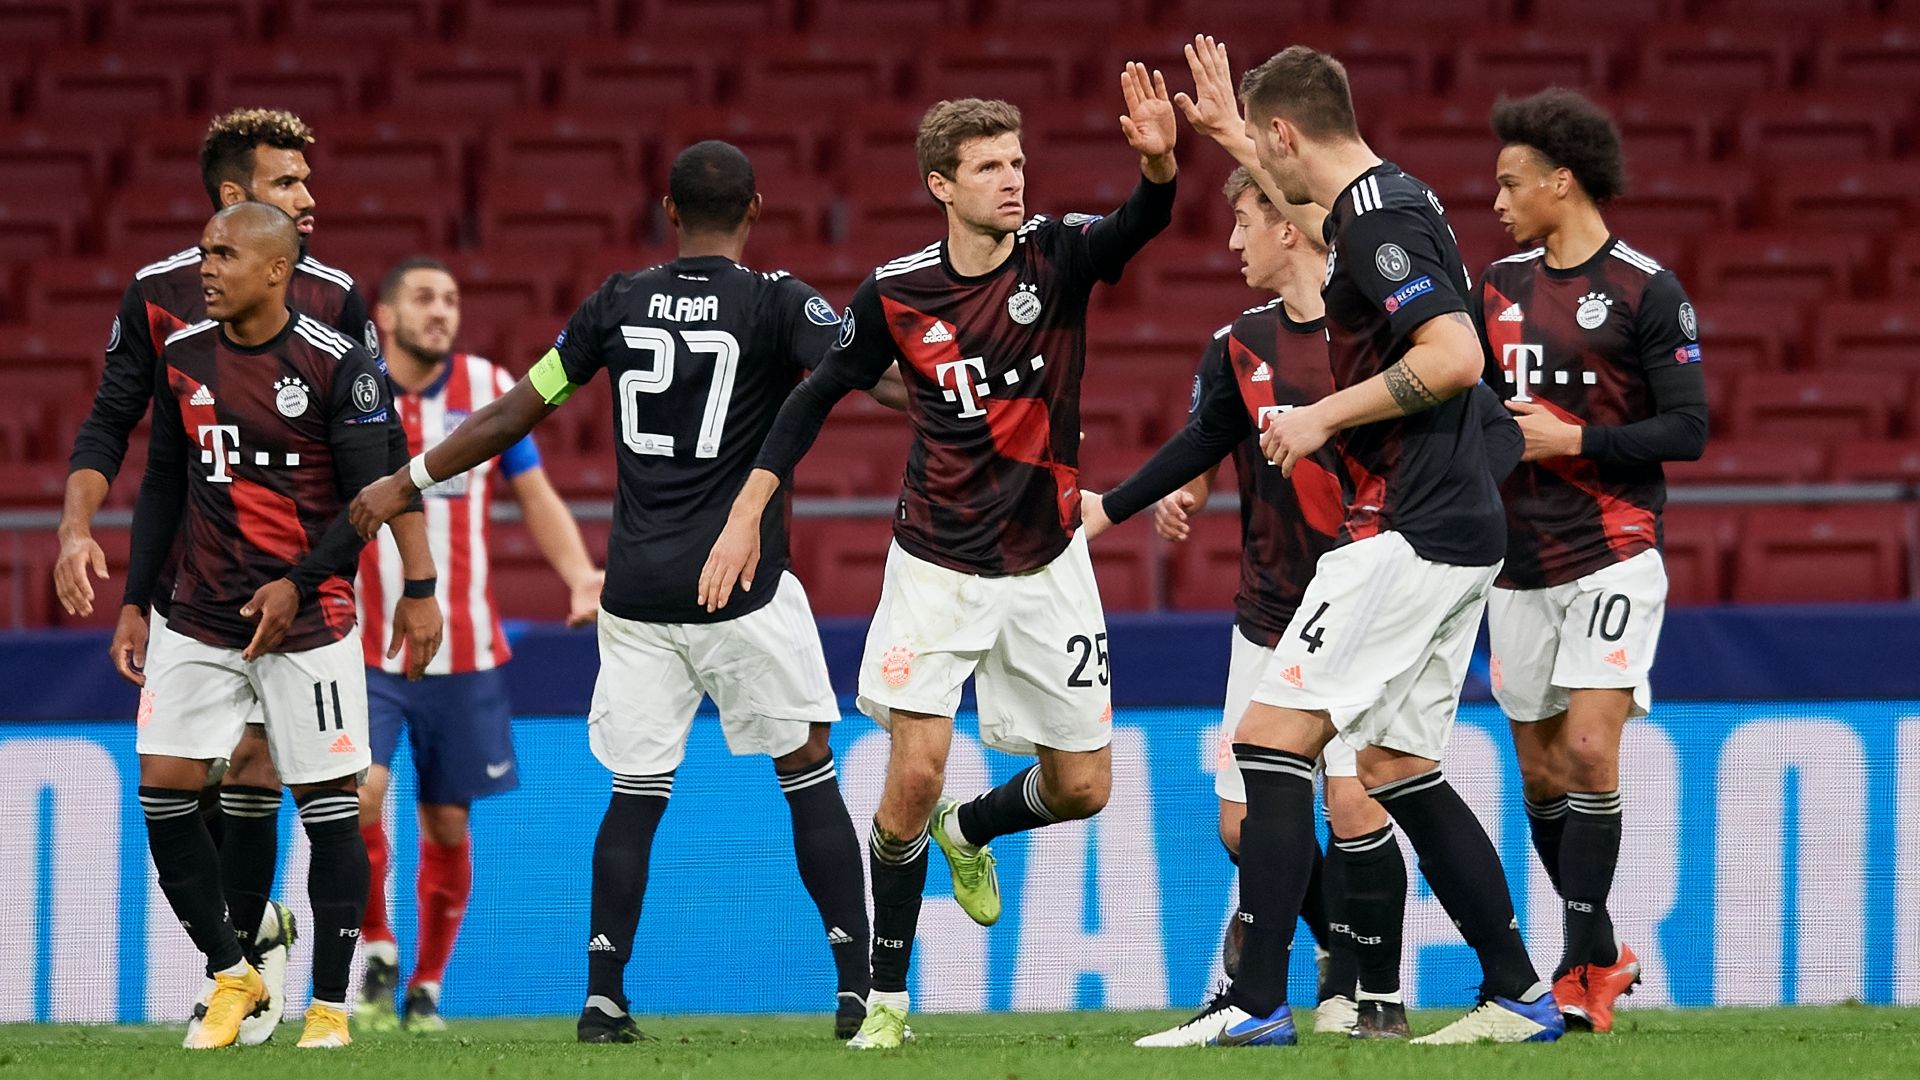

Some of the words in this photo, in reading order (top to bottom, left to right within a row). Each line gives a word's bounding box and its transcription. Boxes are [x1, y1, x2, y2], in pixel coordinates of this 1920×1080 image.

[1396, 279, 1431, 303] RESPECT
[648, 293, 718, 322] ALABA
[923, 332, 953, 344] adidas
[619, 326, 740, 458] 27
[1299, 601, 1330, 654] 4
[1587, 591, 1631, 642] 10
[1066, 632, 1109, 687] 25
[313, 680, 344, 732] 11
[1238, 911, 1254, 924] CB
[1567, 901, 1593, 913] FCB
[876, 936, 904, 949] FCB
[1351, 931, 1382, 945] FCB
